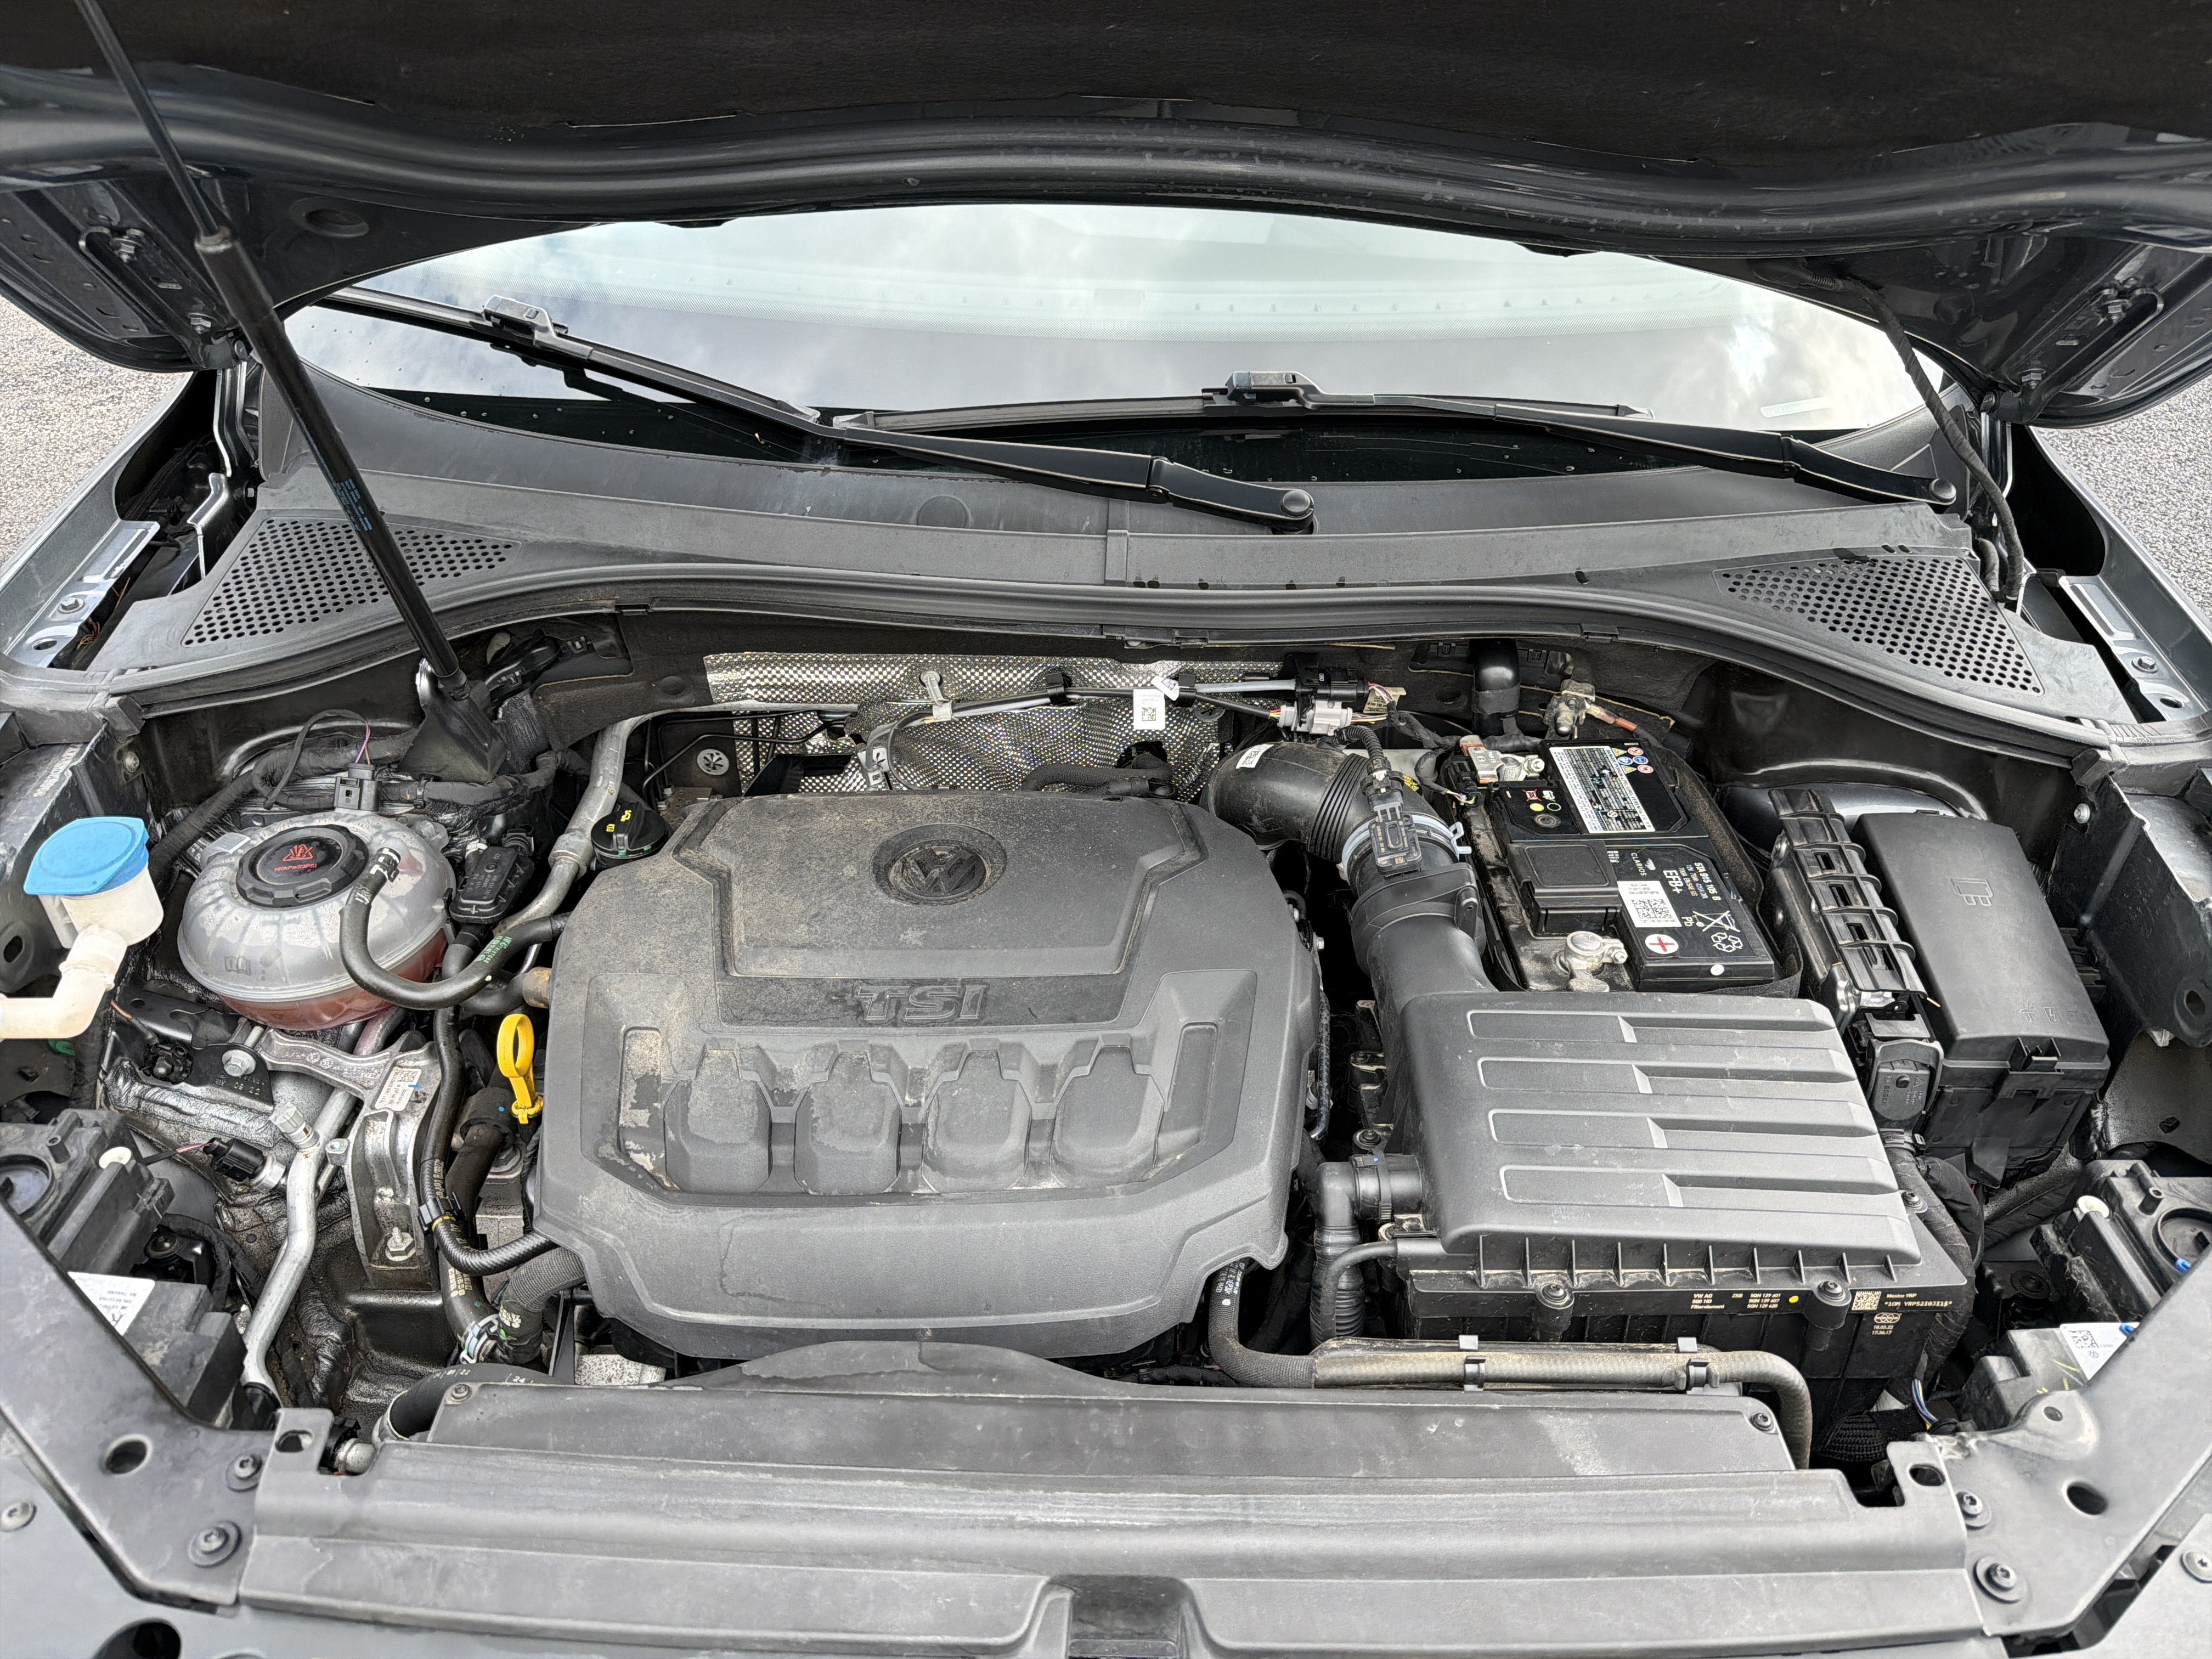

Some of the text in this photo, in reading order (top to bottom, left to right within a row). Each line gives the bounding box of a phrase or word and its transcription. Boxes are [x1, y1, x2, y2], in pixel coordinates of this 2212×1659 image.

[1631, 853, 1647, 876] CLARIOS
[1663, 870, 1684, 894] EFB+
[1694, 862, 1706, 873] 5TA
[1700, 872, 1712, 883] 915
[1706, 883, 1718, 894] 105
[1681, 917, 1695, 927] Pb
[857, 985, 985, 1020] TSI
